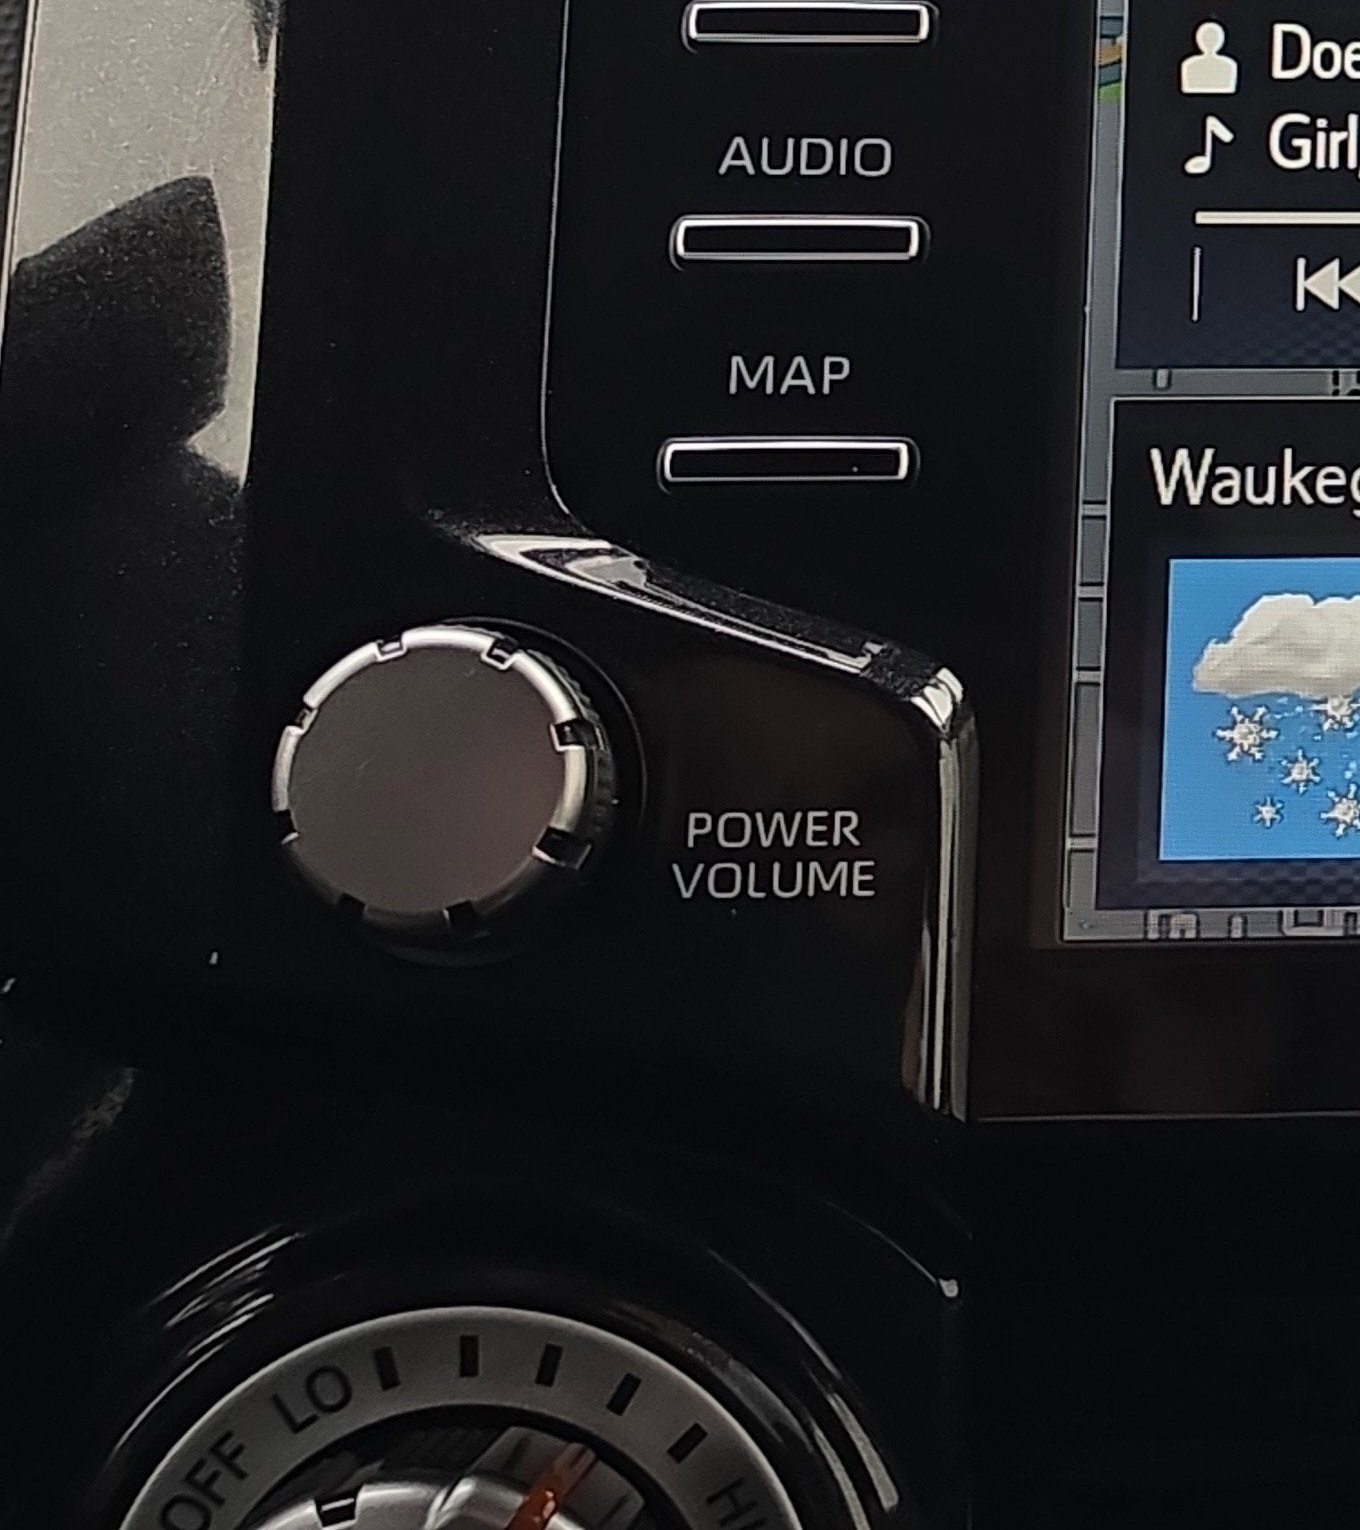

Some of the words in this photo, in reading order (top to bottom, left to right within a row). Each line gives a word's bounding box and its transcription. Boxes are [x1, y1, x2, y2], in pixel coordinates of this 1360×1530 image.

[719, 137, 892, 177] AUDIO
[730, 356, 850, 395] MAP
[687, 810, 861, 848] POWER
[672, 860, 875, 899] VOLUME
[270, 1365, 353, 1435] LO
[160, 1430, 249, 1530] OFF
